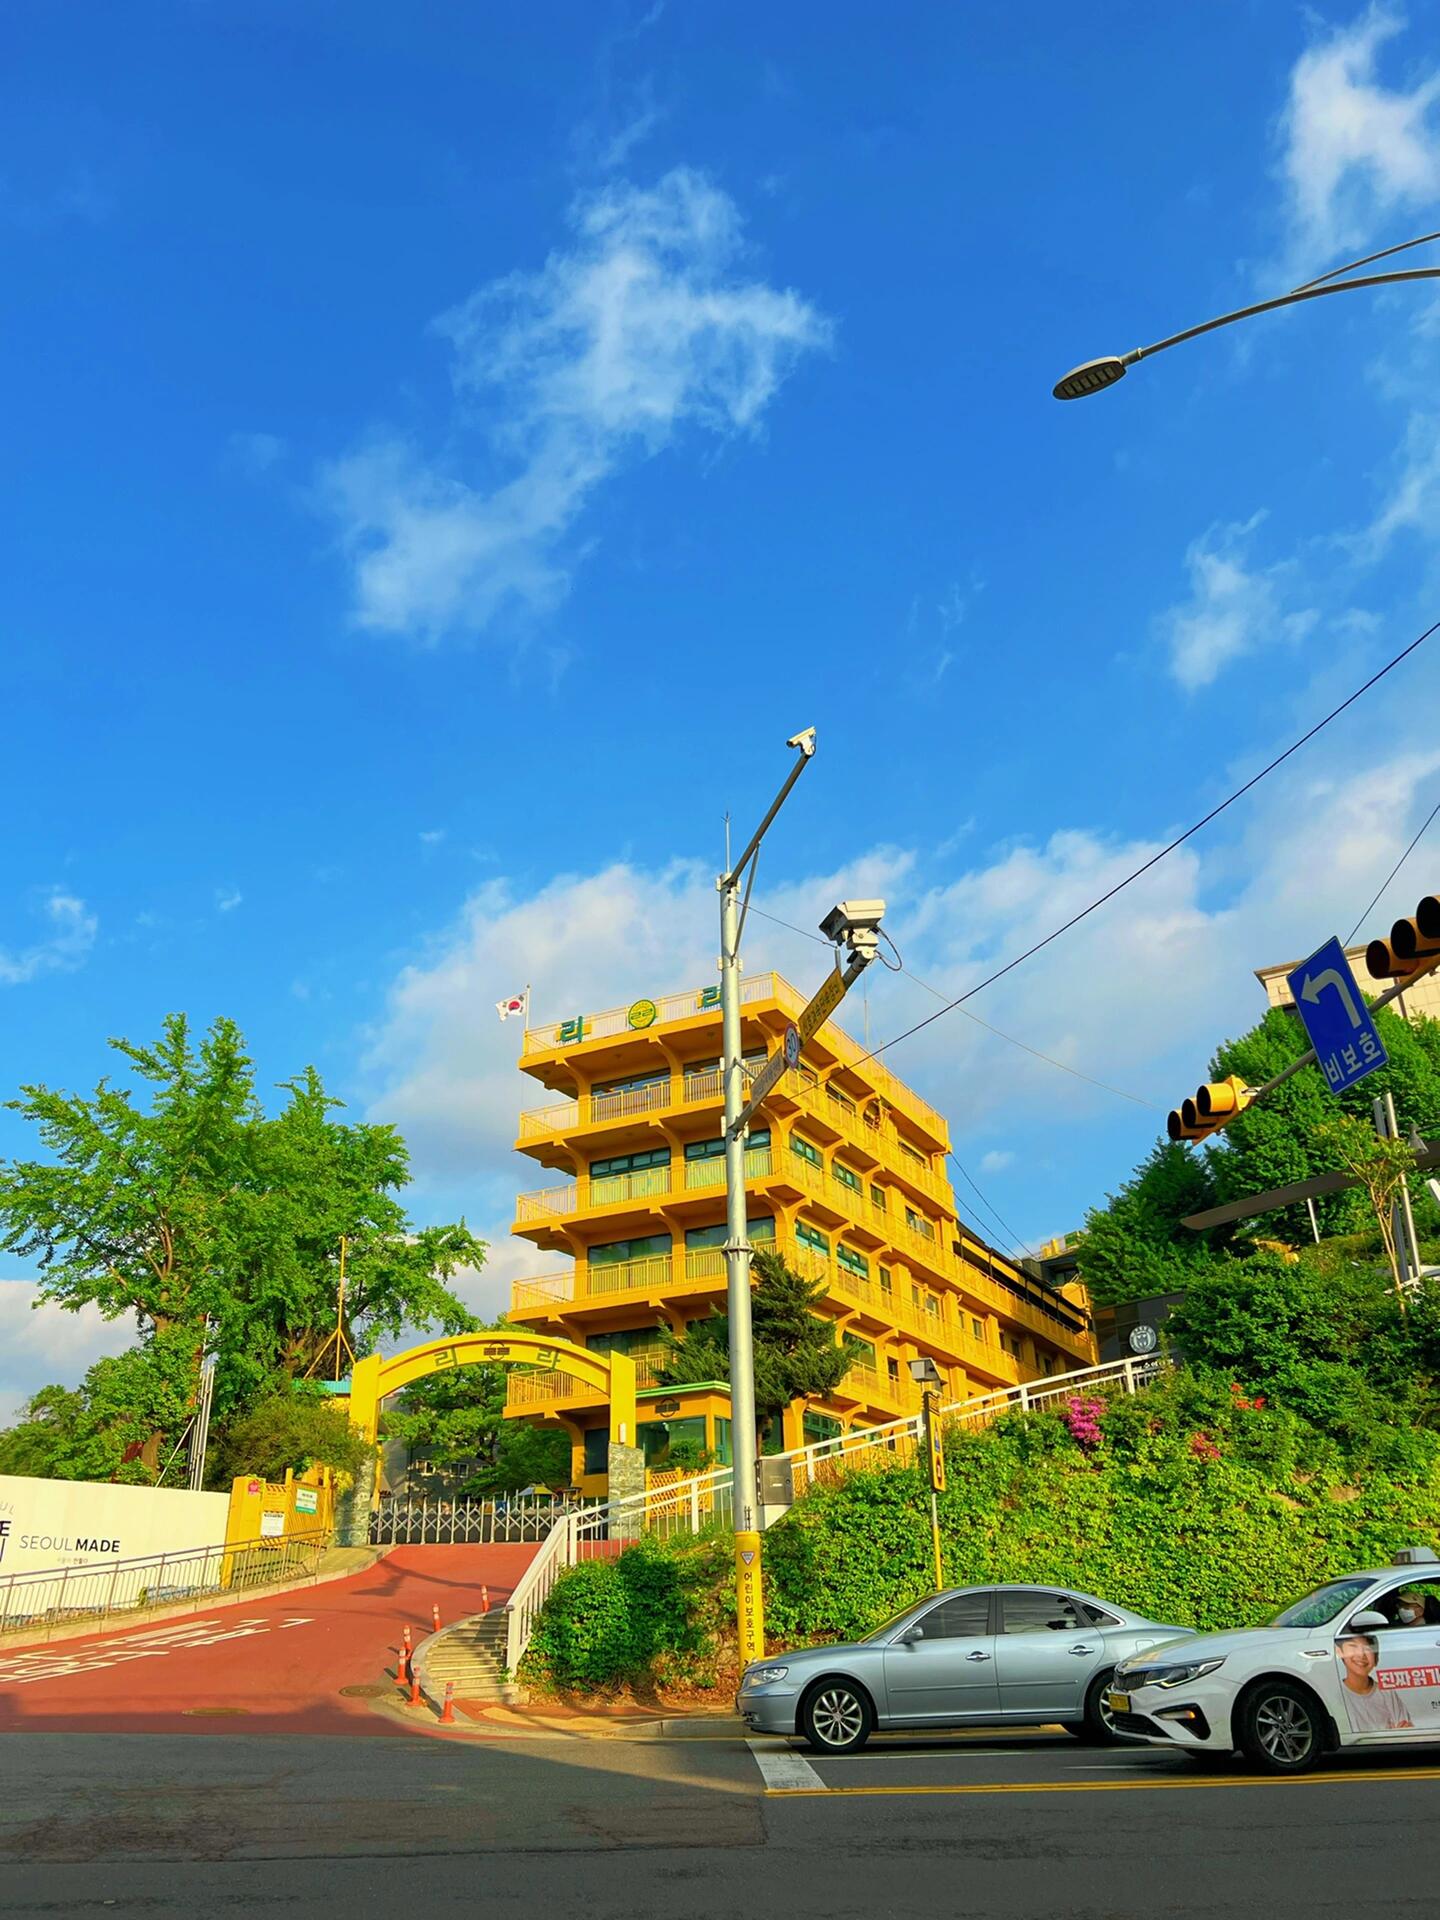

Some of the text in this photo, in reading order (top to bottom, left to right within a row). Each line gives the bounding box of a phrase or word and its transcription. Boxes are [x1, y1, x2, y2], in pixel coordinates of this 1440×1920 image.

[1324, 1032, 1381, 1083] 비보호
[434, 1347, 560, 1369] 리 라
[743, 1572, 755, 1652] 어린이보호구역
